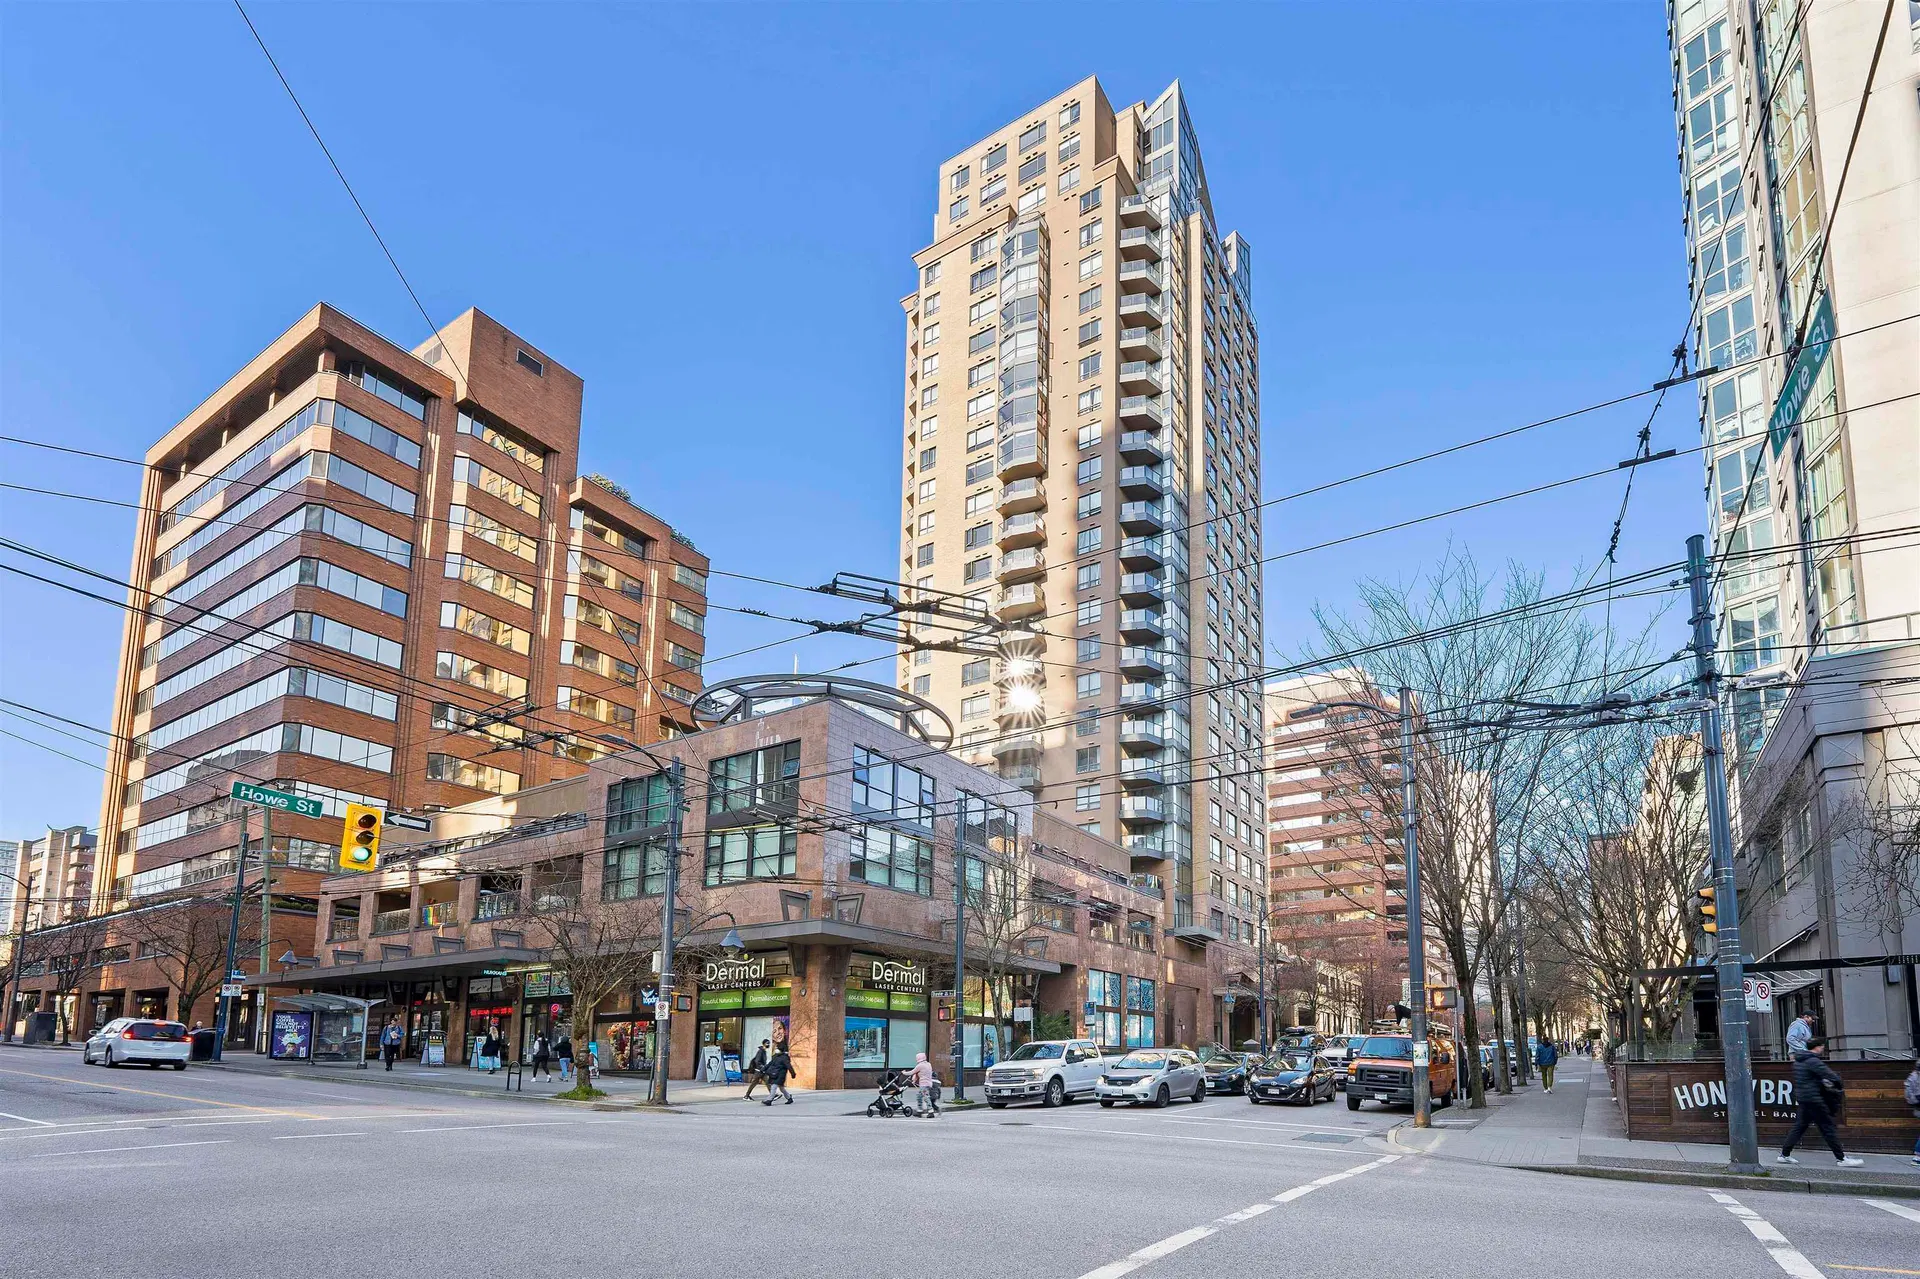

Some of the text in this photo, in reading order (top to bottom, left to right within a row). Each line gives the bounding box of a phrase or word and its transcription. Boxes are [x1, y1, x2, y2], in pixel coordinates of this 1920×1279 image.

[1774, 315, 1830, 443] Howe St
[240, 786, 315, 814] Howe St
[706, 957, 765, 982] Dermal
[872, 961, 925, 986] Dermal
[730, 980, 761, 989] CENTRES
[896, 985, 923, 993] CENTRES
[1773, 1111, 1797, 1119] BAR
